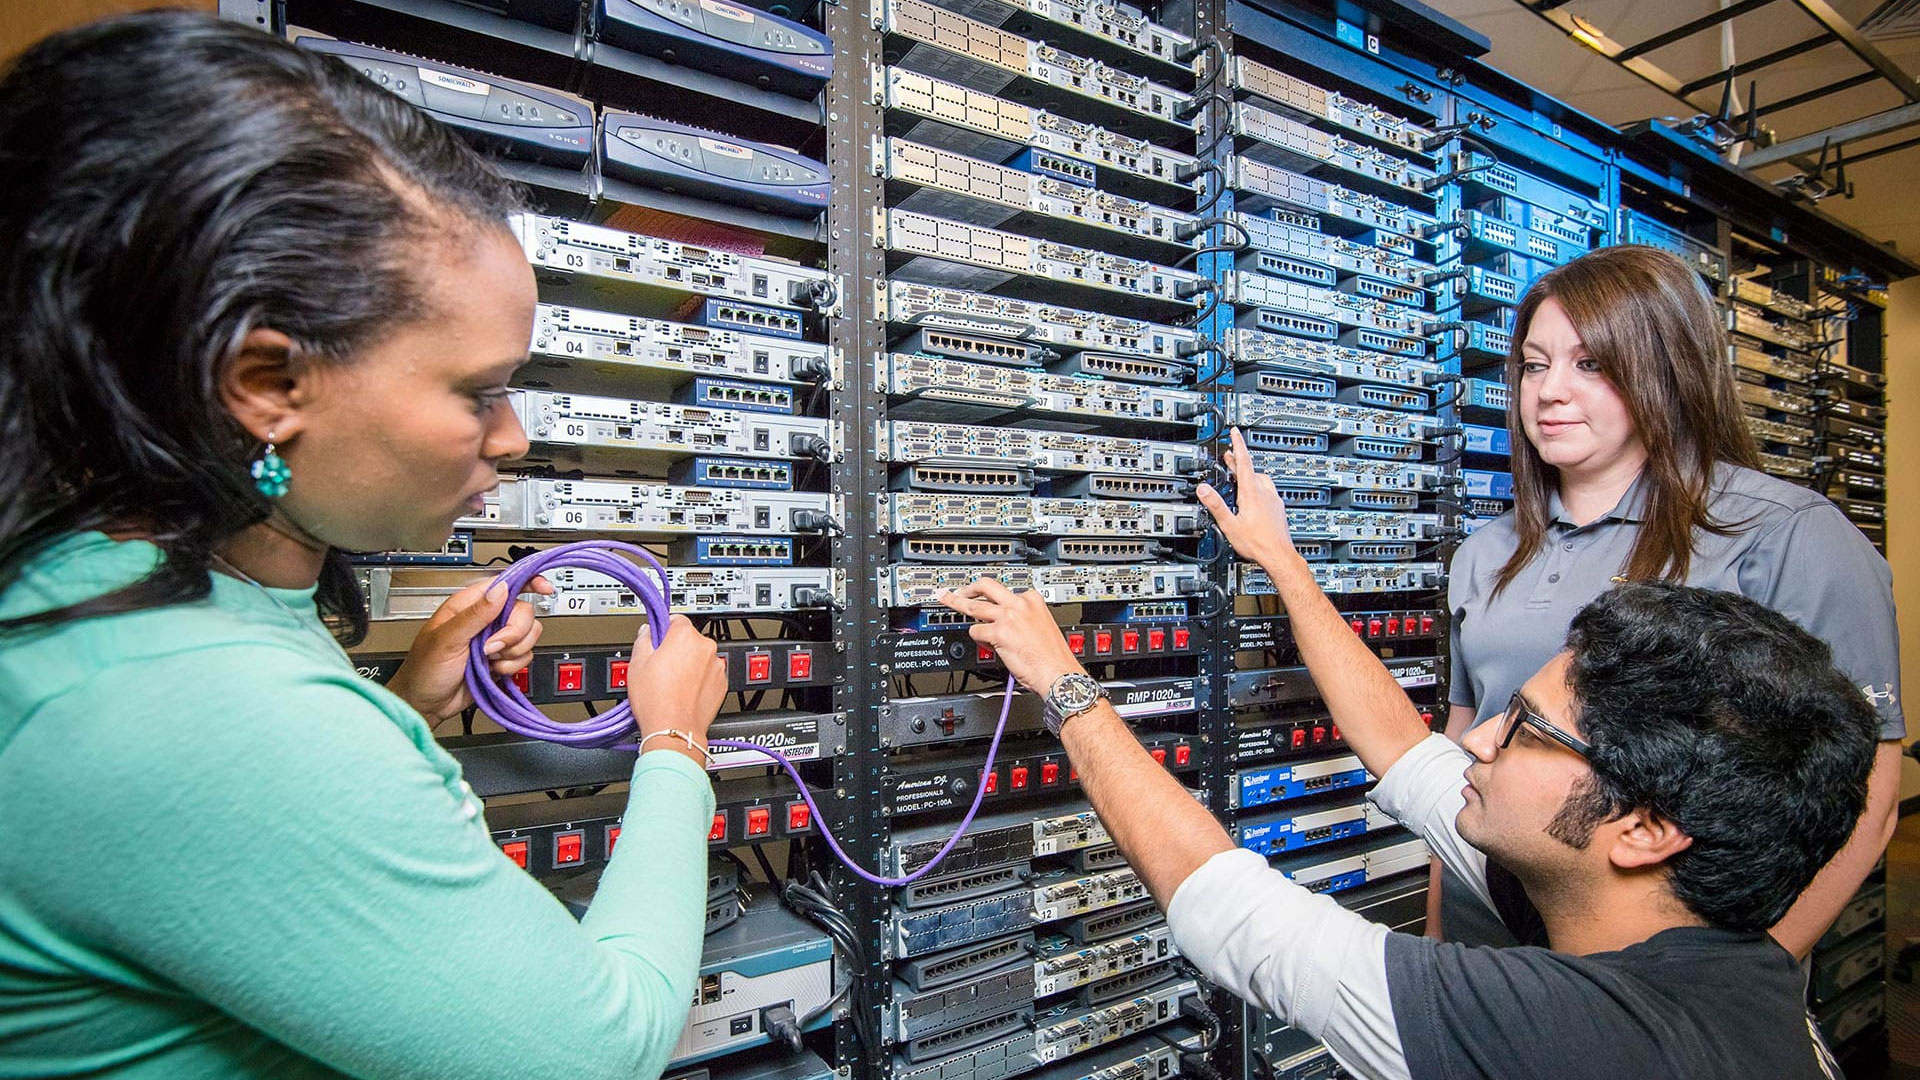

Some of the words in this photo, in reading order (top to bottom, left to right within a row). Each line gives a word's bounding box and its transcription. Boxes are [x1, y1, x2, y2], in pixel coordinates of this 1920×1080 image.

[1037, 1, 1048, 12] 01
[1369, 38, 1377, 49] C
[1038, 66, 1049, 78] 02
[438, 75, 472, 88] SONICWALL
[1039, 134, 1050, 145] 03
[714, 144, 740, 154] SONICWALL
[1038, 202, 1049, 212] 04
[566, 254, 584, 268] 03
[1036, 262, 1047, 273] 05
[1038, 326, 1049, 337] 06
[566, 341, 583, 354] 04
[1038, 396, 1048, 407] 07
[566, 424, 585, 437] 05
[1037, 456, 1048, 466] 08
[565, 511, 583, 524] 06
[568, 597, 586, 610] 07
[895, 637, 929, 648] American
[894, 649, 943, 659] PROFESSIONALS
[1126, 691, 1150, 704] RMP
[896, 779, 932, 791] American
[896, 789, 944, 802] PROFESSIONALS
[511, 830, 517, 838] 2
[1041, 842, 1051, 852] 11
[1041, 909, 1052, 920] 12
[1043, 983, 1054, 993] 13
[1044, 1050, 1054, 1061] 14
